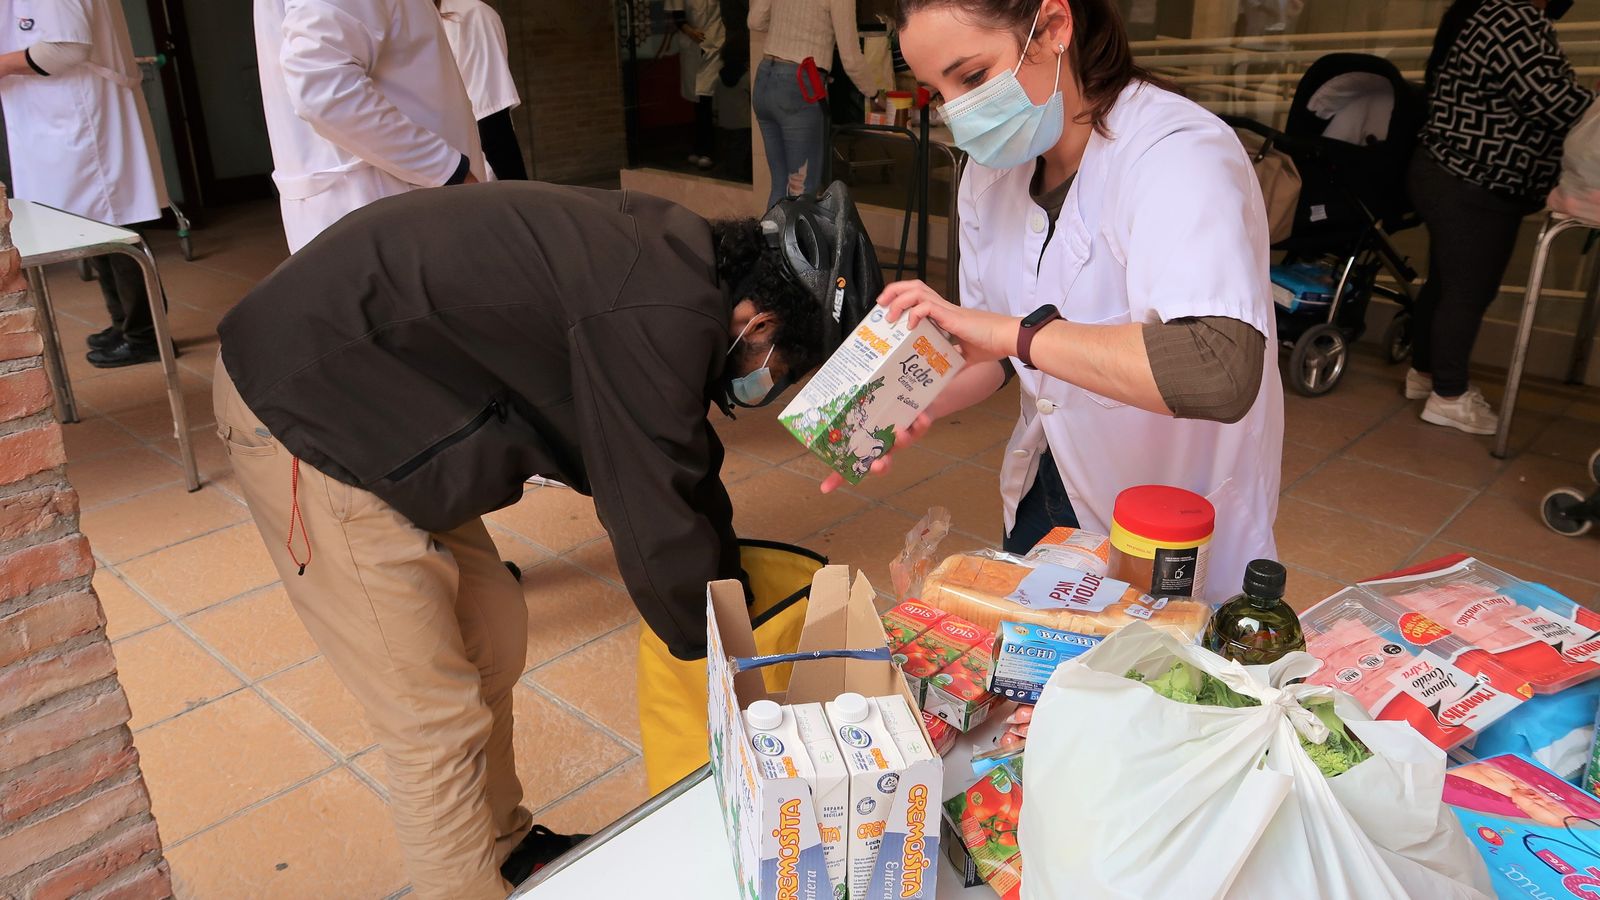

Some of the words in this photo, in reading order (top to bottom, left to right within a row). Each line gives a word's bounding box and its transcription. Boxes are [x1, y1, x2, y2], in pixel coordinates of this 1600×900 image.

[899, 354, 933, 387] Leche
[897, 375, 914, 392] Entera
[896, 394, 904, 402] de
[902, 397, 920, 410] Galicia
[1049, 580, 1076, 602] PAN
[1069, 572, 1104, 605] MOLDE
[904, 604, 932, 619] apis
[946, 623, 975, 640] apis
[1040, 629, 1098, 647] BACHI
[1007, 644, 1055, 660] BACHI
[1345, 671, 1360, 682] BAJO
[1402, 661, 1434, 680] Extra
[1412, 667, 1445, 689] Cocido
[1422, 673, 1458, 698] Jamón
[901, 784, 930, 898] CREMOSITA
[884, 861, 899, 900] Entera
